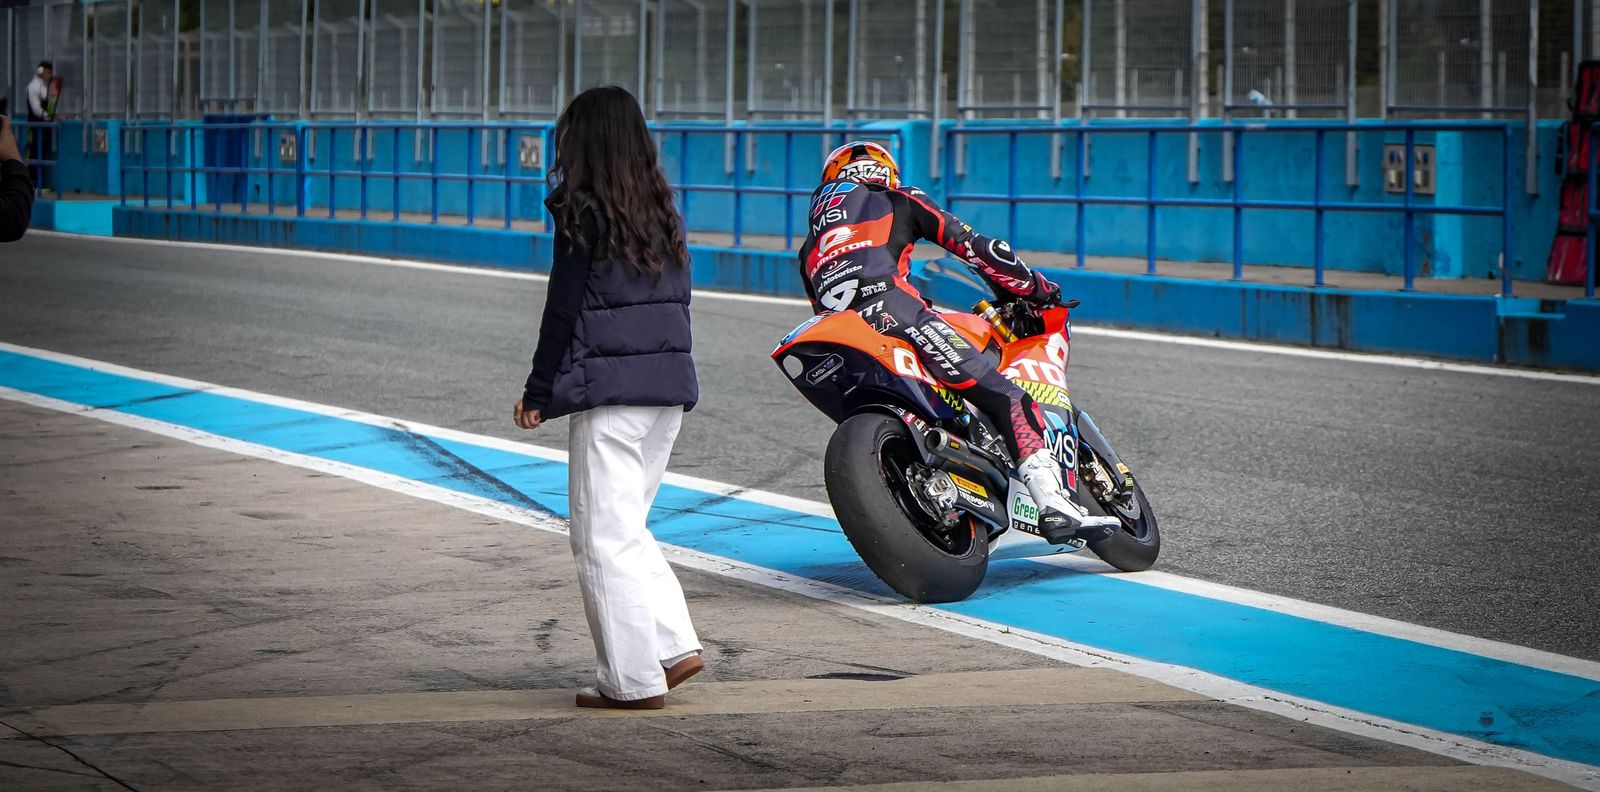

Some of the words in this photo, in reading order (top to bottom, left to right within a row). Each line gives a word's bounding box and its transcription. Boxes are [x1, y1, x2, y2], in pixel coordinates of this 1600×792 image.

[812, 208, 848, 236] MSi
[823, 265, 863, 285] Motorista
[920, 325, 963, 364] FOUNDATION
